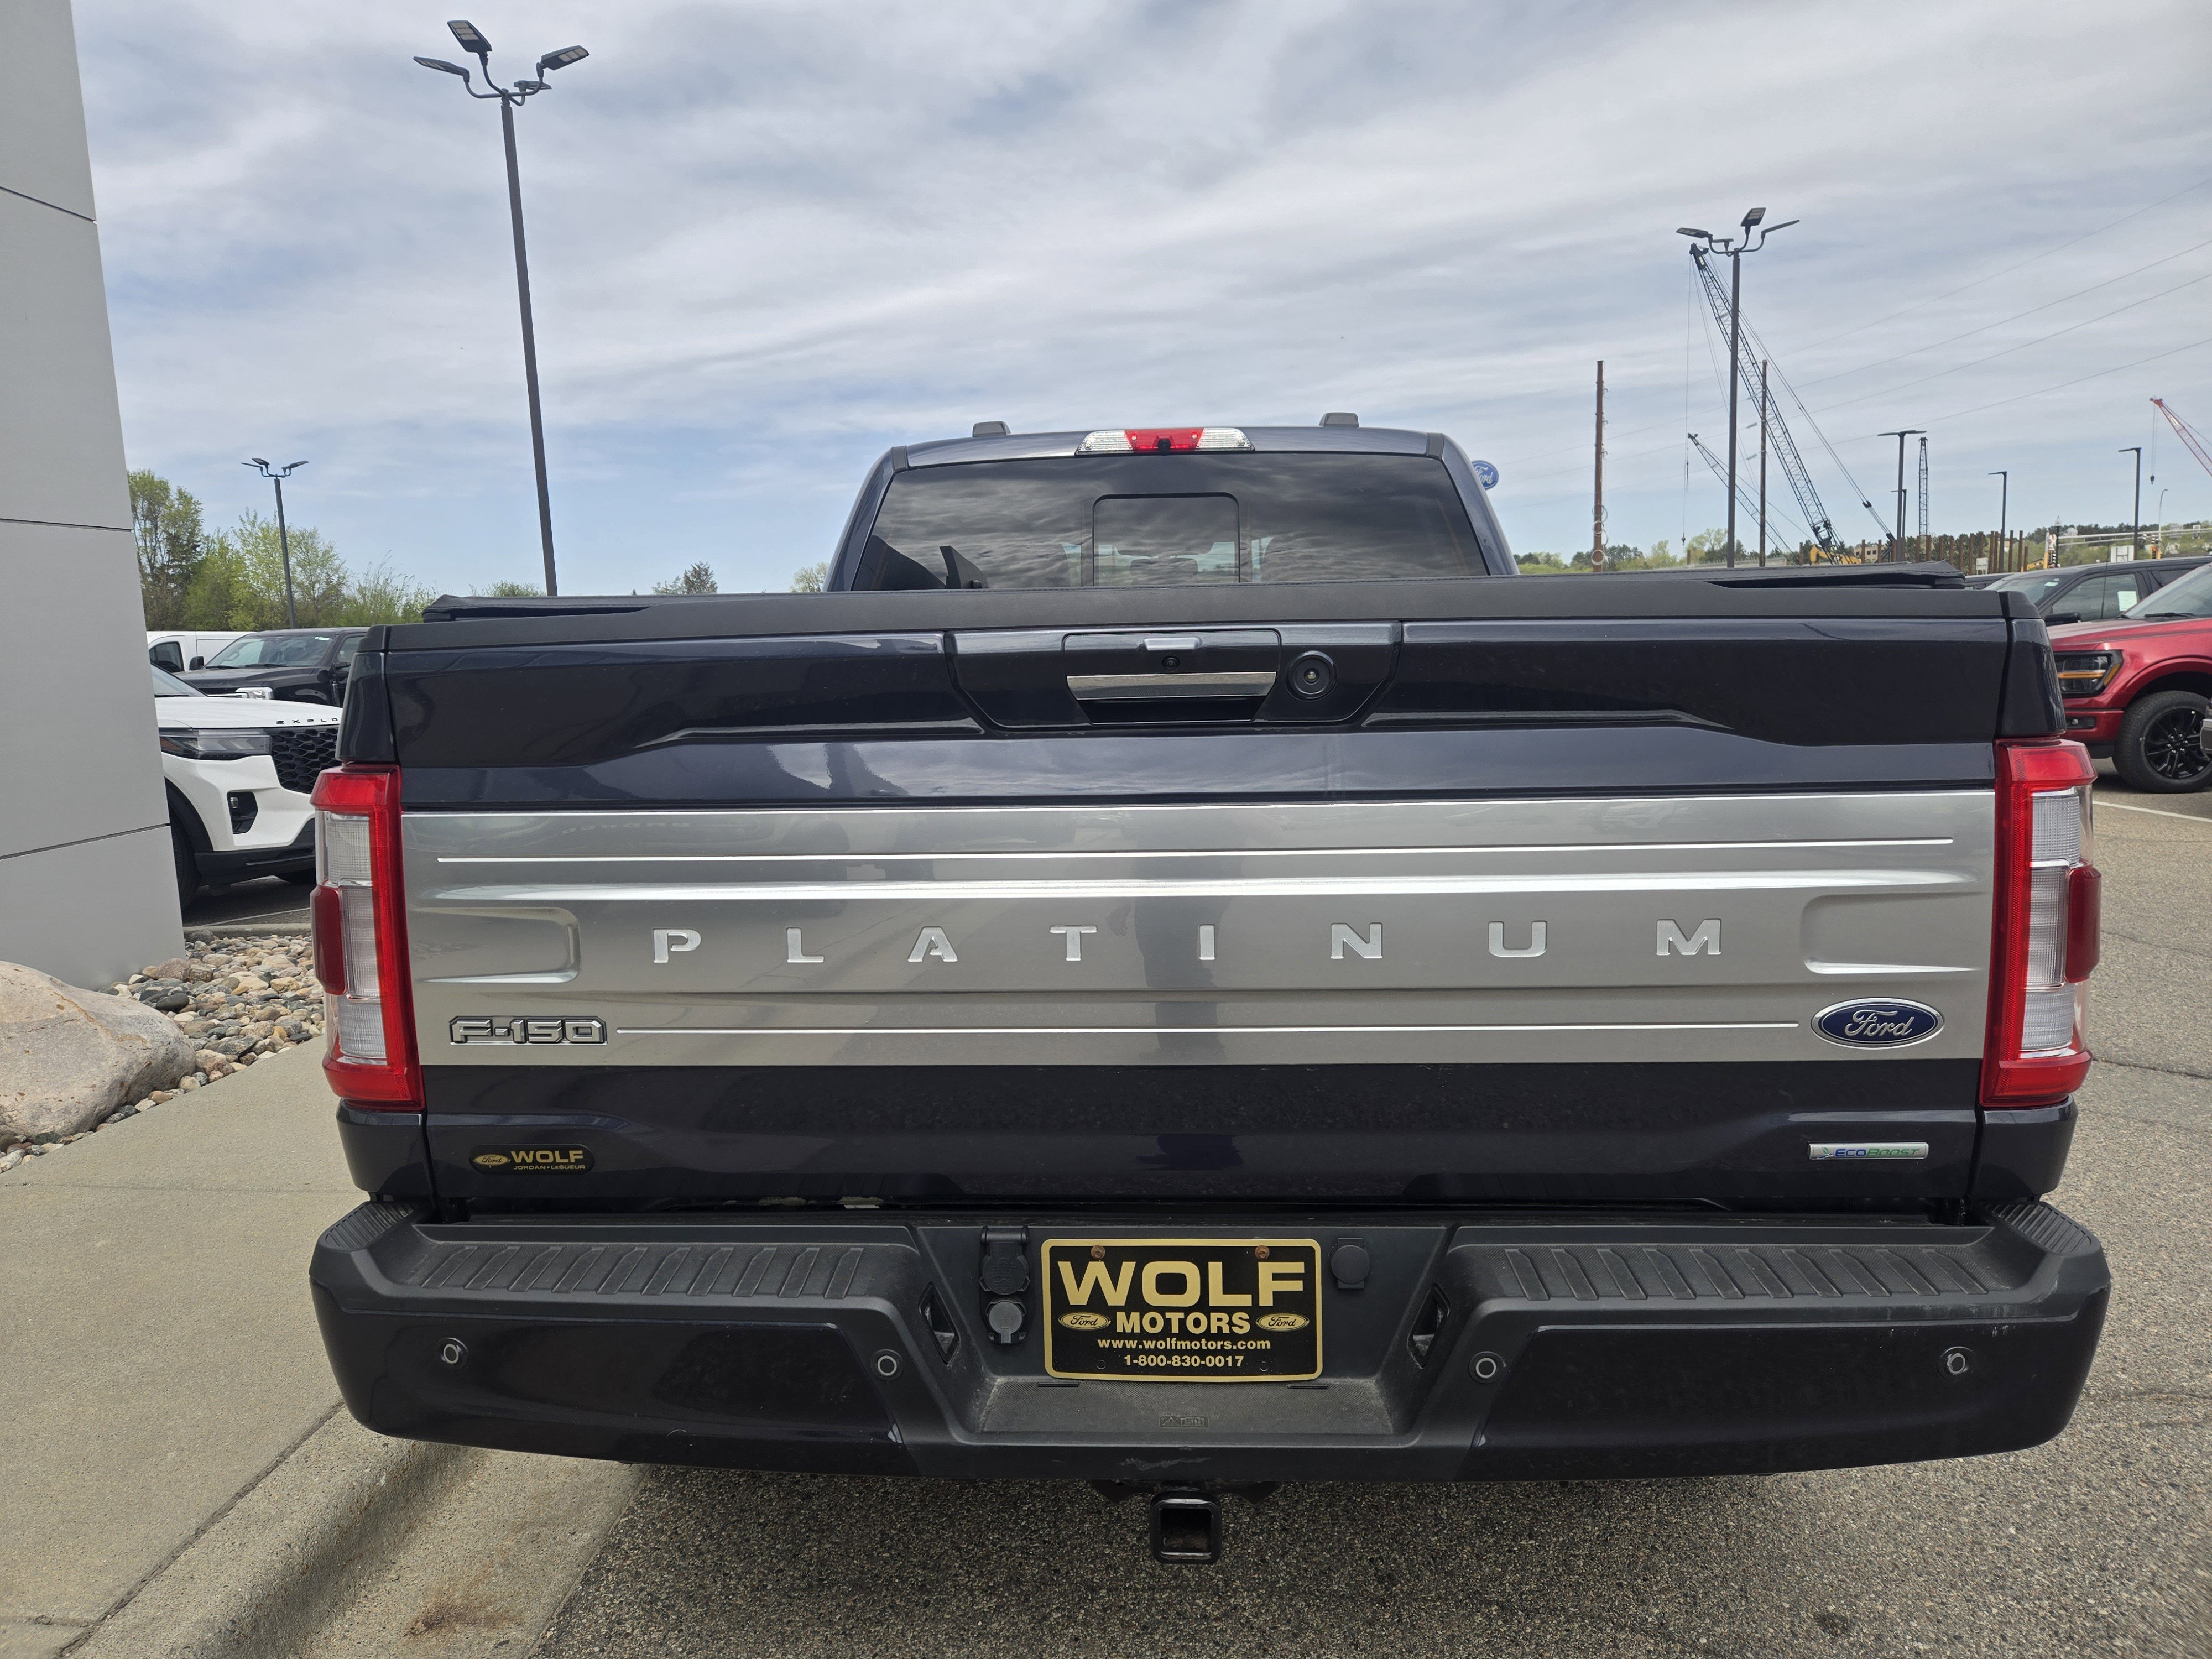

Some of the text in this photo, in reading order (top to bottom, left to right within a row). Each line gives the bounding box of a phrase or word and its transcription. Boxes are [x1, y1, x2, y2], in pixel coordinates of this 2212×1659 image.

[653, 918, 1721, 963] PLATINUM
[449, 1016, 607, 1044] F-150
[1844, 1009, 1914, 1037] Ford
[510, 1150, 583, 1163] WOLF
[1057, 1261, 1305, 1306] WOLF
[1115, 1311, 1251, 1334] MOTORS
[1097, 1338, 1271, 1350] www.wolfmotors.com
[1123, 1355, 1245, 1368] 1-800-830-0017
